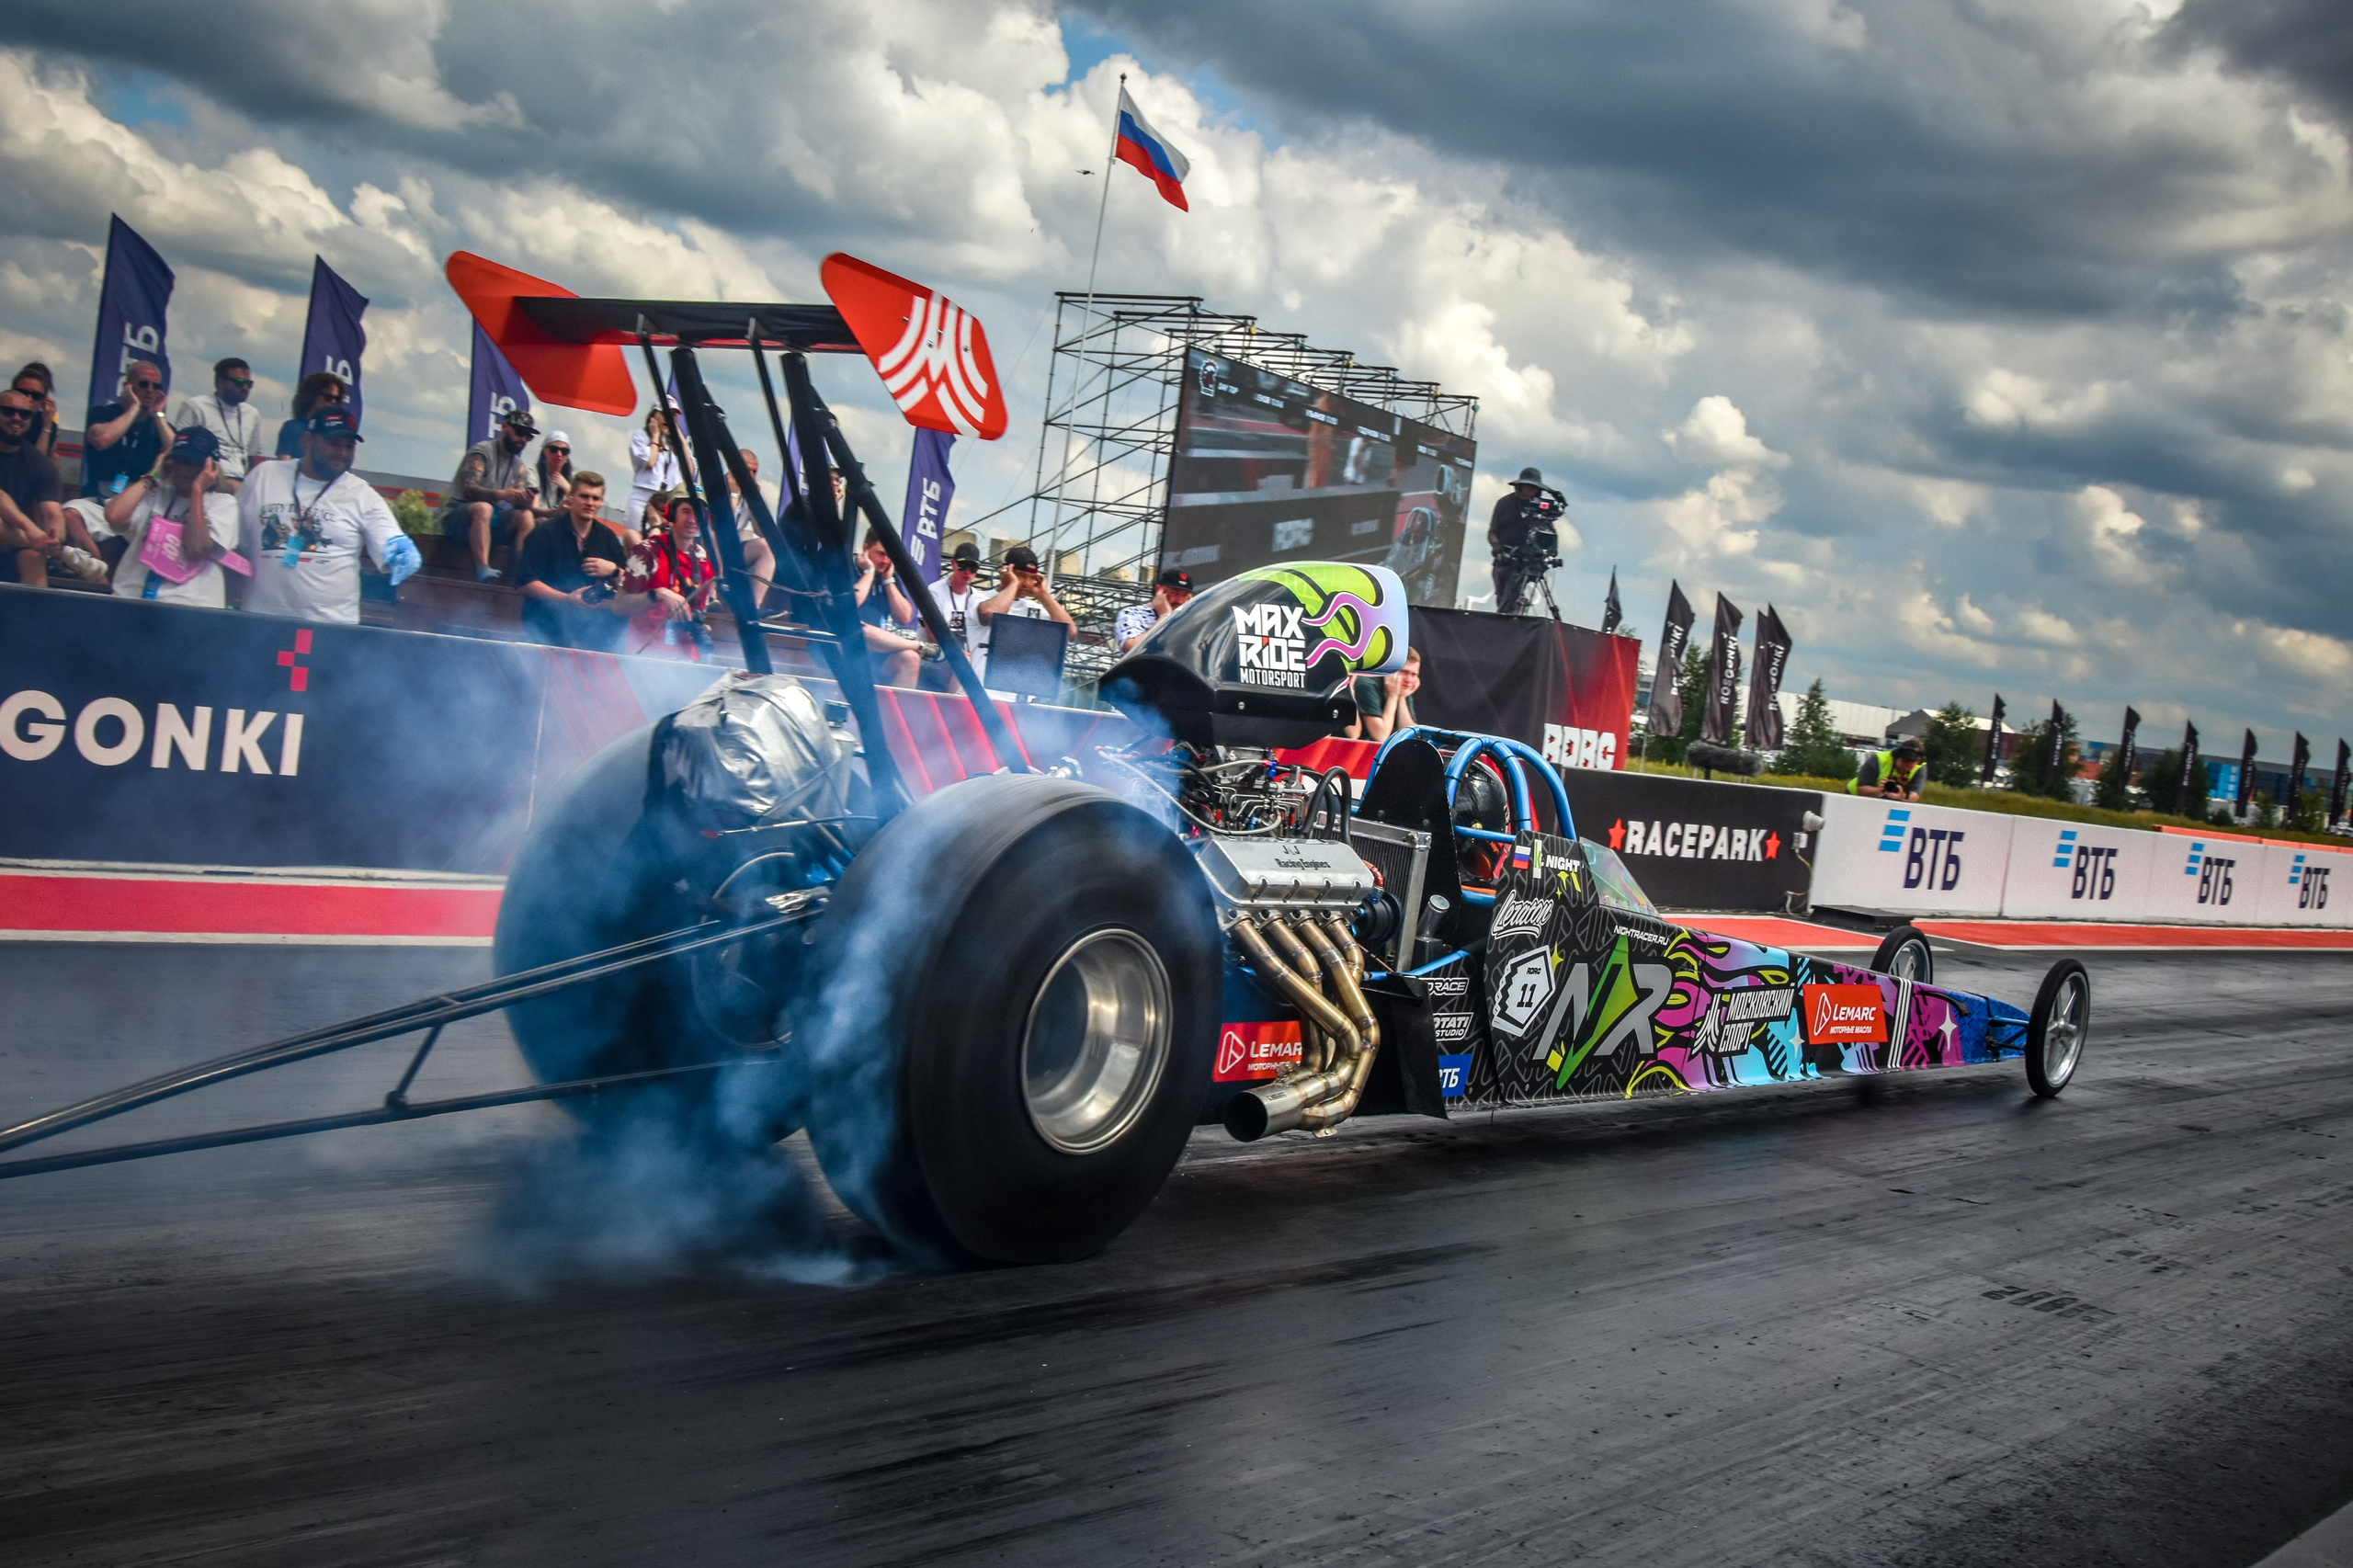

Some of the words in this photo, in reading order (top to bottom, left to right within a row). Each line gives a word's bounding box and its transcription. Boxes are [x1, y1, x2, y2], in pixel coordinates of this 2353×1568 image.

[916, 476, 941, 540] ВТБ
[1232, 603, 1305, 639] MAX
[1238, 634, 1306, 672] RIDE
[1240, 667, 1305, 688] MOTORSPORT
[0, 689, 304, 776] GONKI
[1624, 821, 1768, 861] RACEPARK
[1904, 827, 1964, 891] ВТБ
[2072, 846, 2118, 900] ВТБ
[2198, 856, 2235, 905] ВТБ
[2300, 867, 2330, 909] ВТБ
[1613, 925, 1669, 946] NIGHTRACER.RU
[1517, 983, 1537, 1007] 11
[1726, 983, 1796, 1021] МОСКОВСКИЙ
[1833, 1004, 1877, 1021] LEMARC
[1718, 1022, 1755, 1052] СПОРТ
[1830, 1026, 1855, 1035] МОТОРНЫЕ
[1856, 1026, 1872, 1034] МАСЛА
